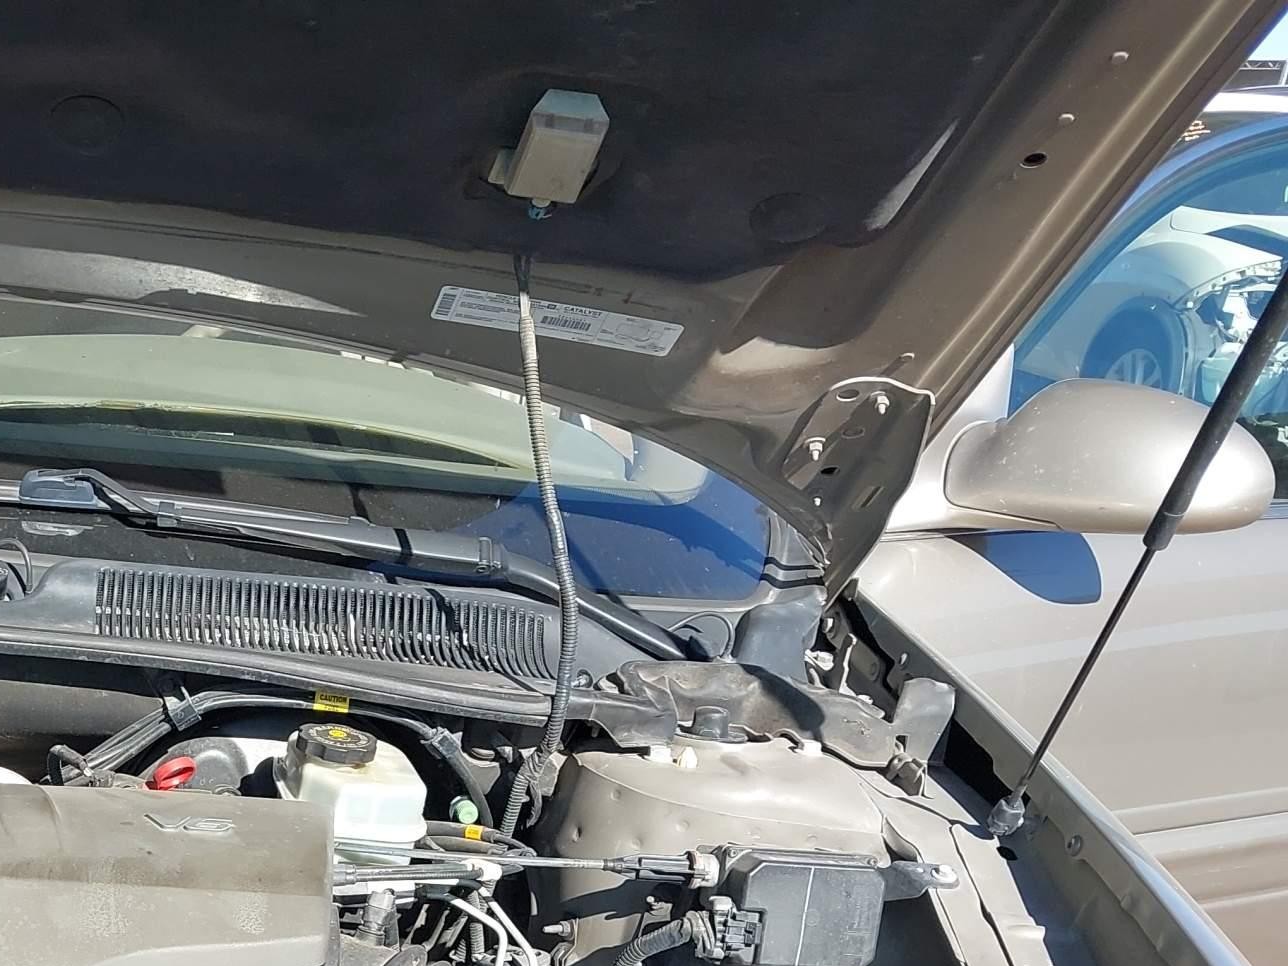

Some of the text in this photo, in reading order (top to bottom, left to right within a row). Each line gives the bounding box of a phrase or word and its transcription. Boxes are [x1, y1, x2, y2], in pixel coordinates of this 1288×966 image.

[563, 306, 602, 317] CATALYST
[319, 693, 348, 703] CAUTION
[144, 813, 237, 835] V6
